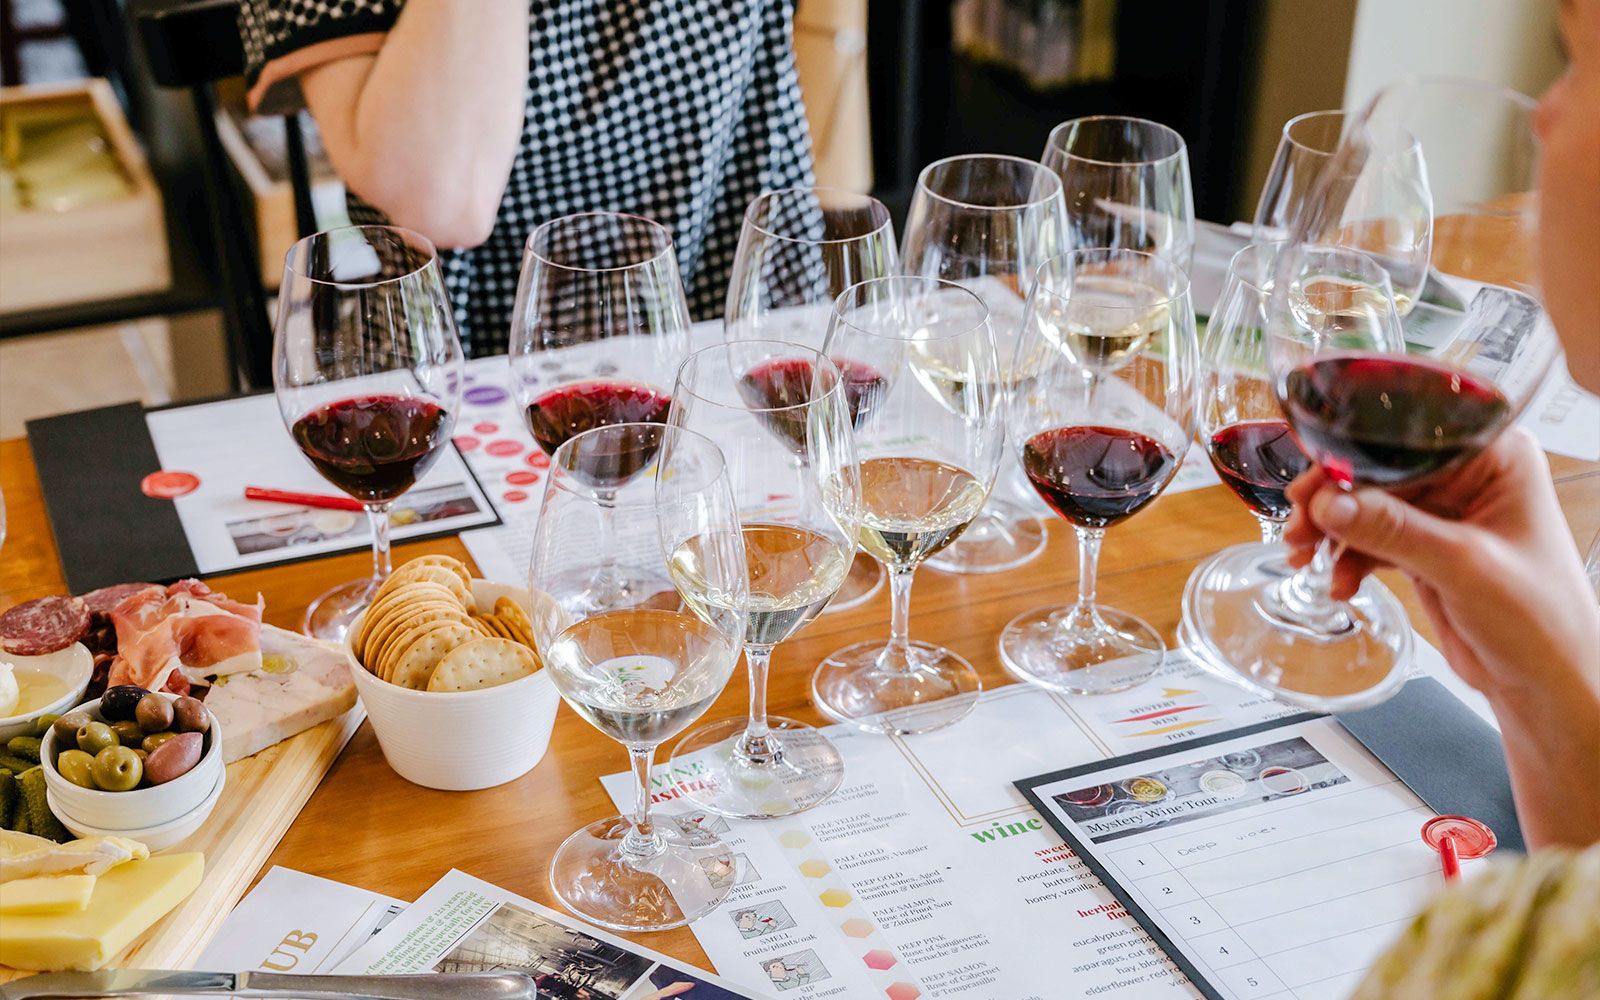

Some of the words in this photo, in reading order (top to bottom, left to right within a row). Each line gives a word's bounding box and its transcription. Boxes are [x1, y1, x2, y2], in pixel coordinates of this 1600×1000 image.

[1129, 700, 1177, 715] MYSTERY
[1152, 715, 1182, 727] WINE
[1166, 730, 1197, 741] TOUR
[811, 820, 835, 831] PALE
[834, 812, 871, 826] YELLOW
[1087, 814, 1144, 834] Mystery
[1144, 804, 1183, 819] Wine
[1183, 795, 1219, 810] Tour
[815, 825, 847, 837] Chenin
[970, 818, 1043, 843] wine
[834, 853, 858, 865] PALE
[858, 847, 885, 859] GOLD
[893, 844, 929, 857] Viognier
[1176, 840, 1217, 857] Deep
[851, 877, 877, 889] DEEP
[877, 871, 904, 883] GOLD
[856, 882, 888, 895] Dessert
[887, 876, 918, 889] wines,
[919, 869, 940, 881] Aged
[1016, 866, 1069, 883] chocolate,
[1042, 871, 1097, 889] butterscot
[738, 890, 754, 900] the
[755, 884, 788, 897] aromas
[860, 888, 899, 902] Semillon
[910, 876, 944, 890] Riesling
[1025, 891, 1061, 905] honey,
[1061, 881, 1098, 896] vanilla,
[1162, 886, 1173, 895] 2
[872, 906, 897, 917] PALE
[896, 896, 936, 911] SALMON
[877, 912, 899, 924] Rose
[900, 910, 909, 919] of
[910, 904, 933, 917] Pinot
[933, 900, 953, 911] Noir
[1077, 900, 1122, 918] herbal
[892, 912, 933, 928] Zinfandel
[1189, 915, 1201, 925] 3
[385, 943, 416, 970] crafting
[413, 925, 438, 948] classic
[443, 891, 478, 920] emerging
[401, 943, 431, 968] tailored
[428, 915, 464, 946] especially
[460, 904, 474, 919] for
[472, 895, 486, 908] the
[760, 932, 793, 945] SMELL
[1072, 927, 1132, 948] eucalyptus,
[368, 956, 387, 971] four
[386, 922, 429, 958] generations
[419, 939, 451, 966] LOVERS
[448, 928, 461, 942] OF
[460, 914, 478, 931] THE
[743, 933, 817, 957] fruits/plants/oak
[897, 940, 923, 952] DEEP
[923, 934, 947, 945] PINK
[902, 947, 925, 958] Rose
[925, 944, 935, 954] of
[935, 932, 986, 951] Sangiovese,
[1096, 941, 1127, 955] green
[1128, 934, 1154, 948] pepp
[907, 949, 950, 966] Grenache
[960, 938, 990, 952] Merlot
[1072, 955, 1128, 974] asparagus,
[1128, 949, 1146, 960] cut
[1146, 945, 1163, 956] gra
[1219, 946, 1230, 955] 4
[920, 971, 946, 984] DEEP
[946, 960, 987, 976] SALMON
[1115, 964, 1140, 976] hay,
[1139, 956, 1172, 970] blosso
[1150, 968, 1168, 980] red
[925, 980, 949, 992] Rose
[949, 976, 959, 986] of
[959, 966, 1000, 981] Cabernet
[939, 976, 997, 996] Tempranillo
[1246, 977, 1259, 987] 5
[799, 984, 816, 994] SIP
[815, 984, 848, 999] tongue
